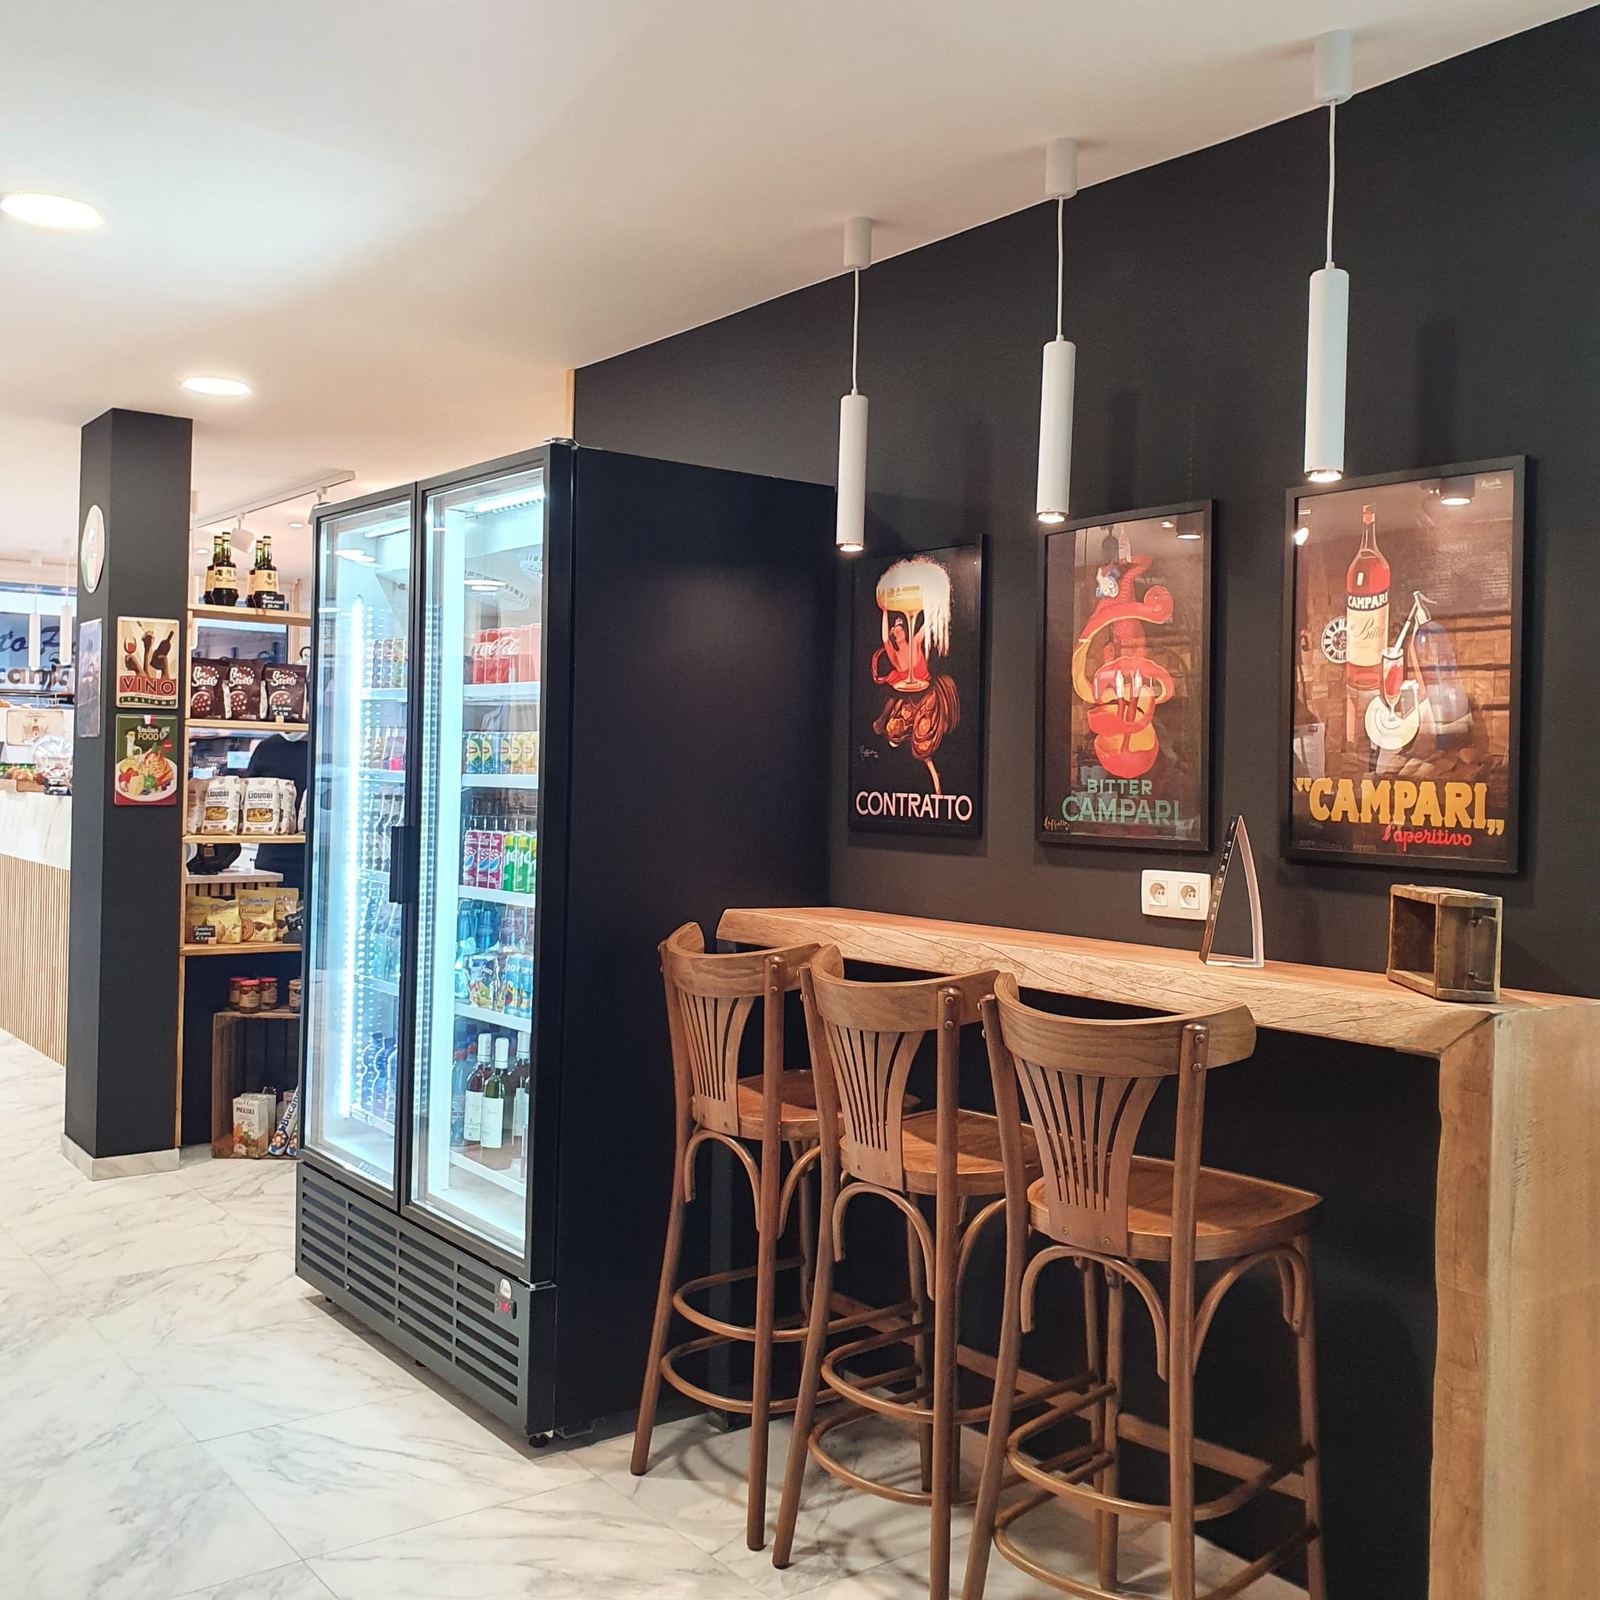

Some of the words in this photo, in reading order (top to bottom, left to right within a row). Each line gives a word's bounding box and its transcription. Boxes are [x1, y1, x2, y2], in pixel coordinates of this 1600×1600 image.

[1347, 591, 1388, 610] CAMPARI
[122, 676, 175, 696] VINO
[137, 732, 159, 740] FOOD
[248, 791, 273, 799] LIGUORI
[1087, 778, 1153, 795] BITTER
[856, 791, 973, 821] CONTRATTO
[1061, 796, 1181, 827] CAMPARI
